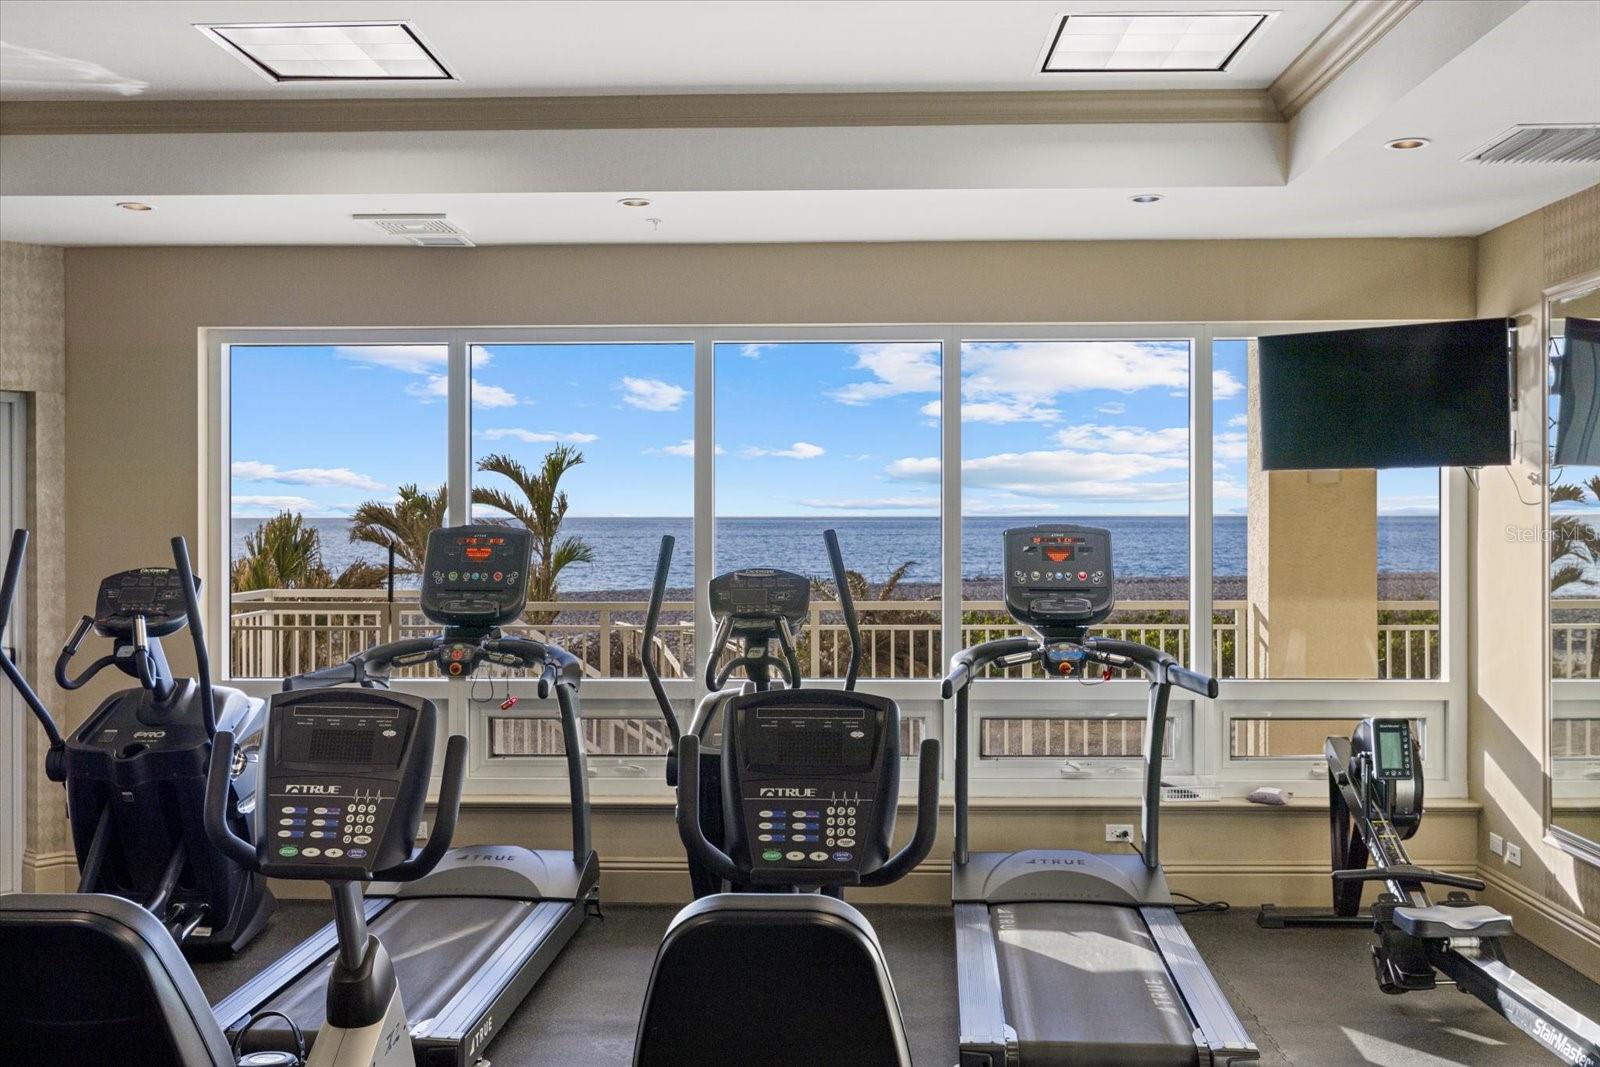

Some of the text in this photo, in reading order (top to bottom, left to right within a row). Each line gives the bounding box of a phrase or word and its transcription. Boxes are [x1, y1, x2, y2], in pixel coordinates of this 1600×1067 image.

[300, 785, 341, 794] TRUE
[774, 788, 817, 797] TRUE
[475, 1016, 493, 1048] TRUE
[1532, 1018, 1592, 1067] StairMaster
